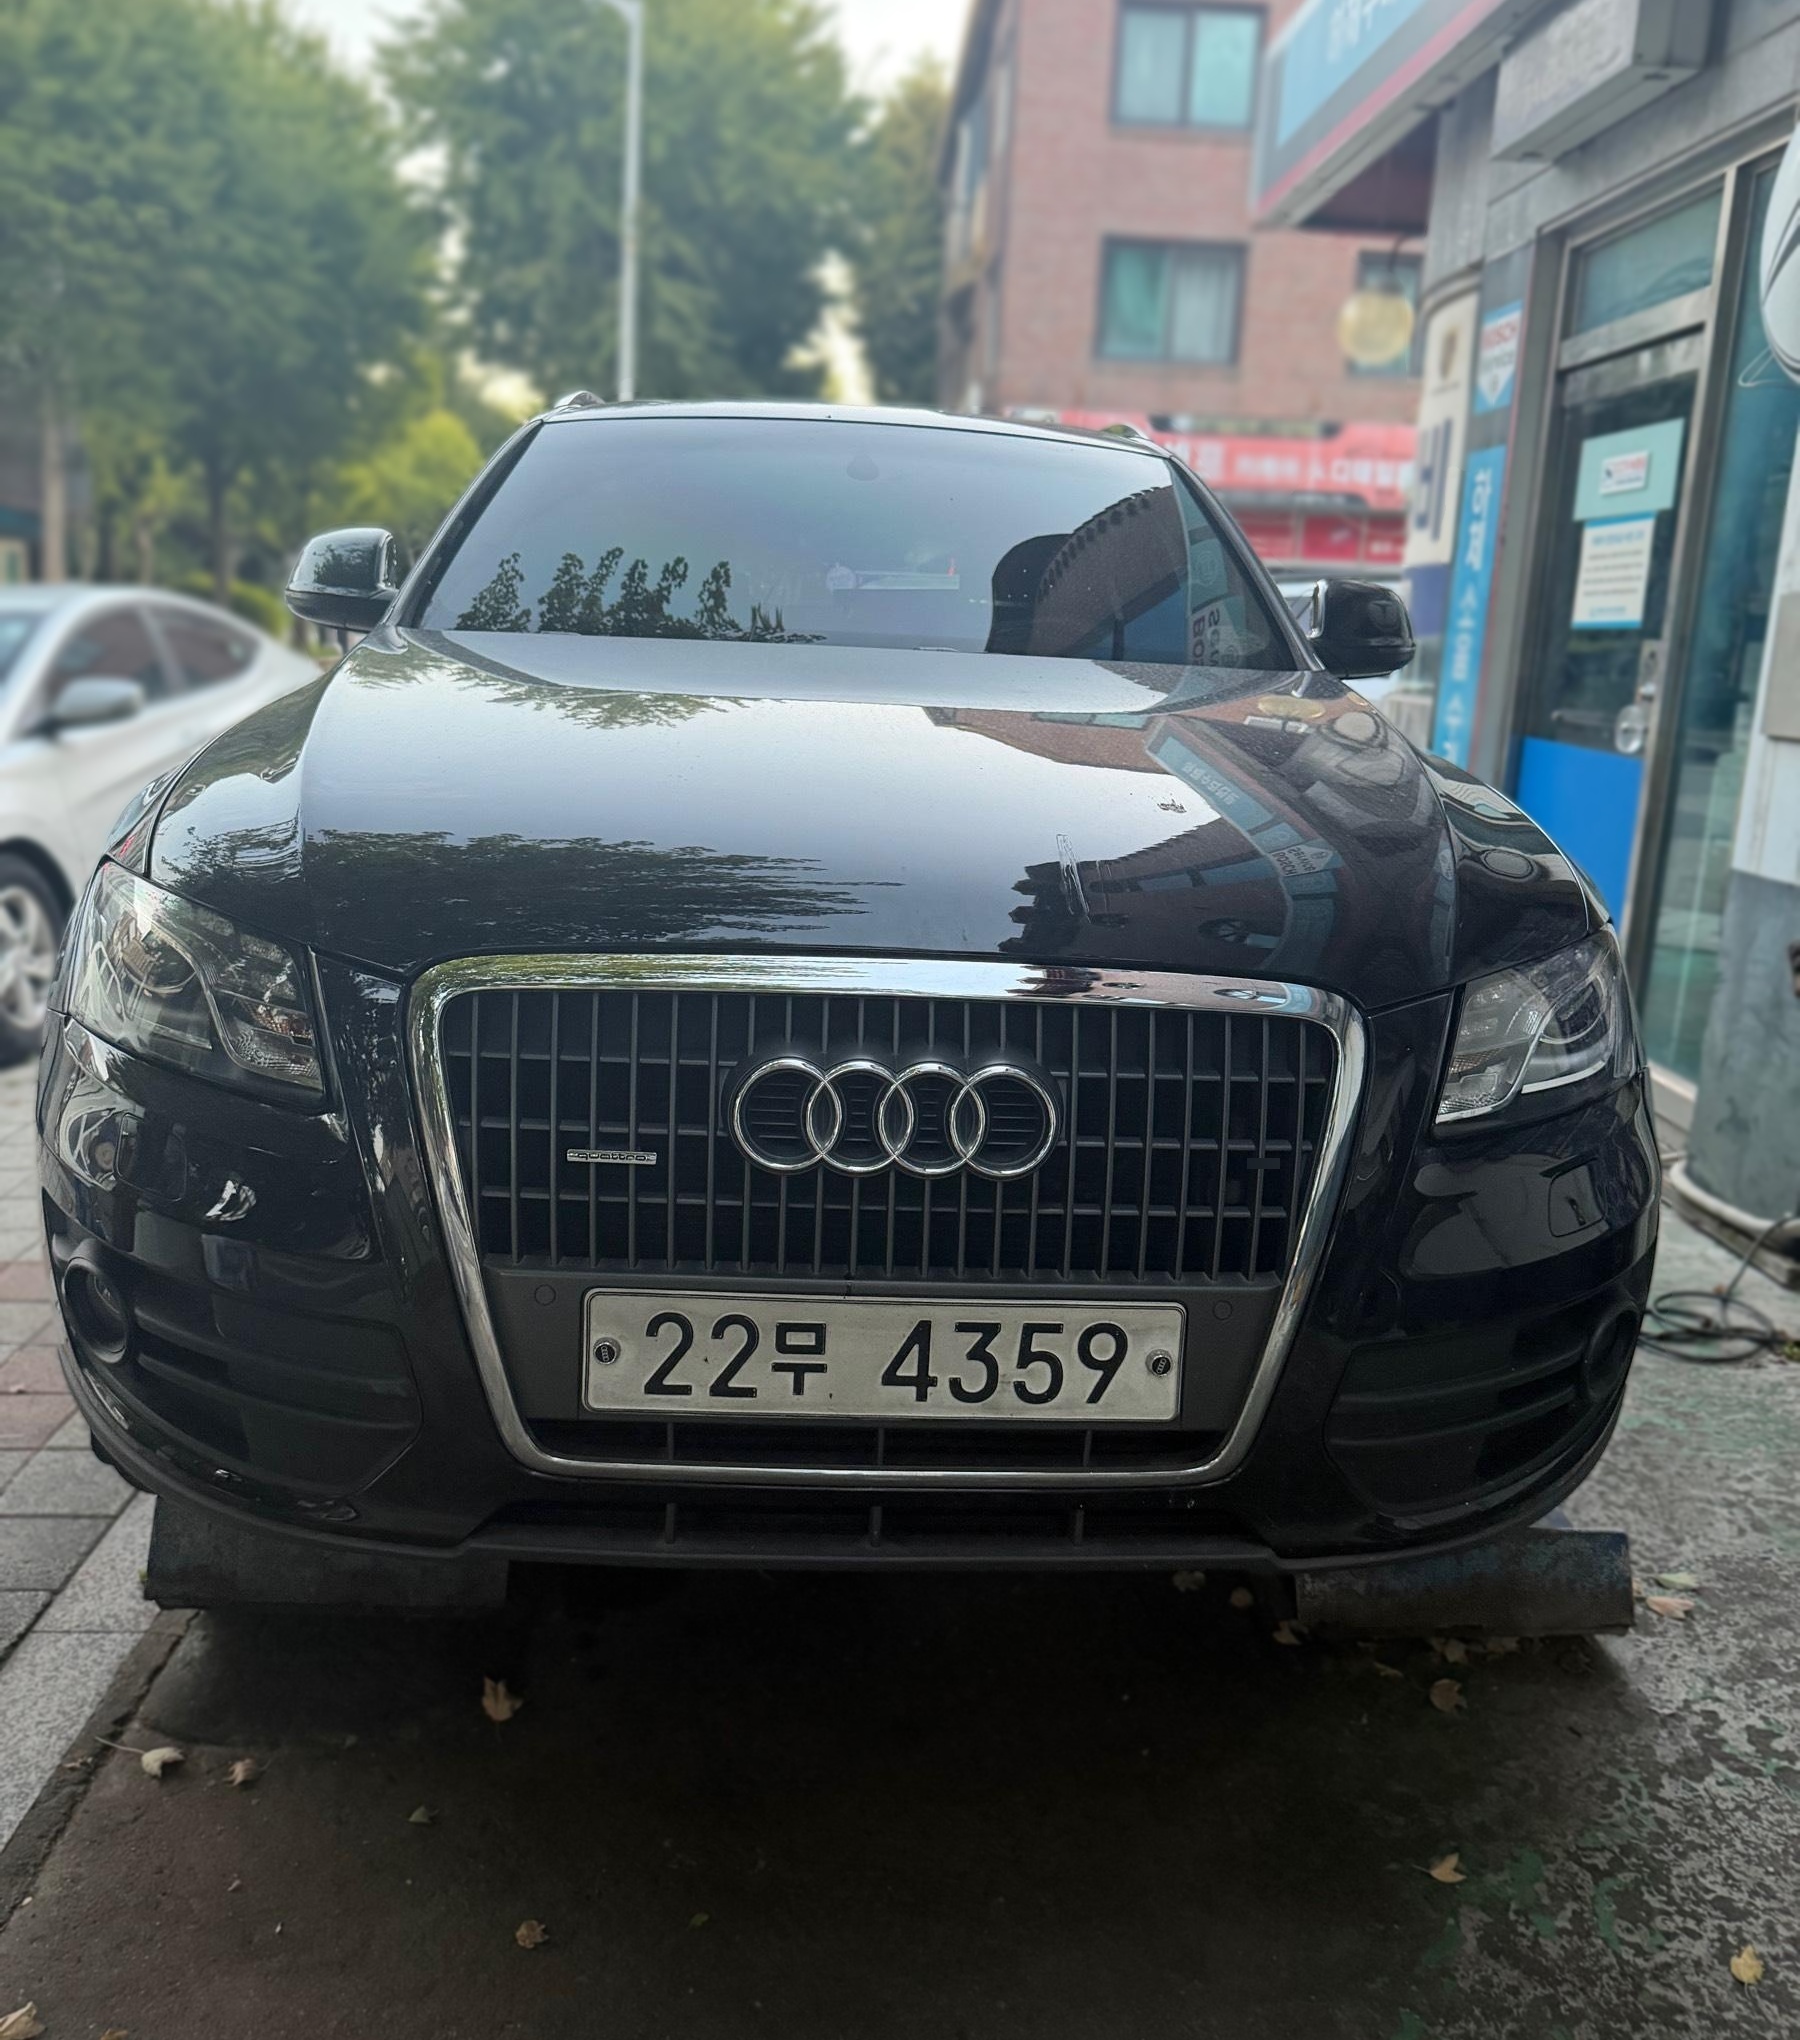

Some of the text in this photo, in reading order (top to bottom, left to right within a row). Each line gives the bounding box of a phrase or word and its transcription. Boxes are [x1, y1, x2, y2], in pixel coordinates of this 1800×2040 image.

[576, 1151, 648, 1163] quattro
[643, 1311, 1129, 1405] 22무 4359
